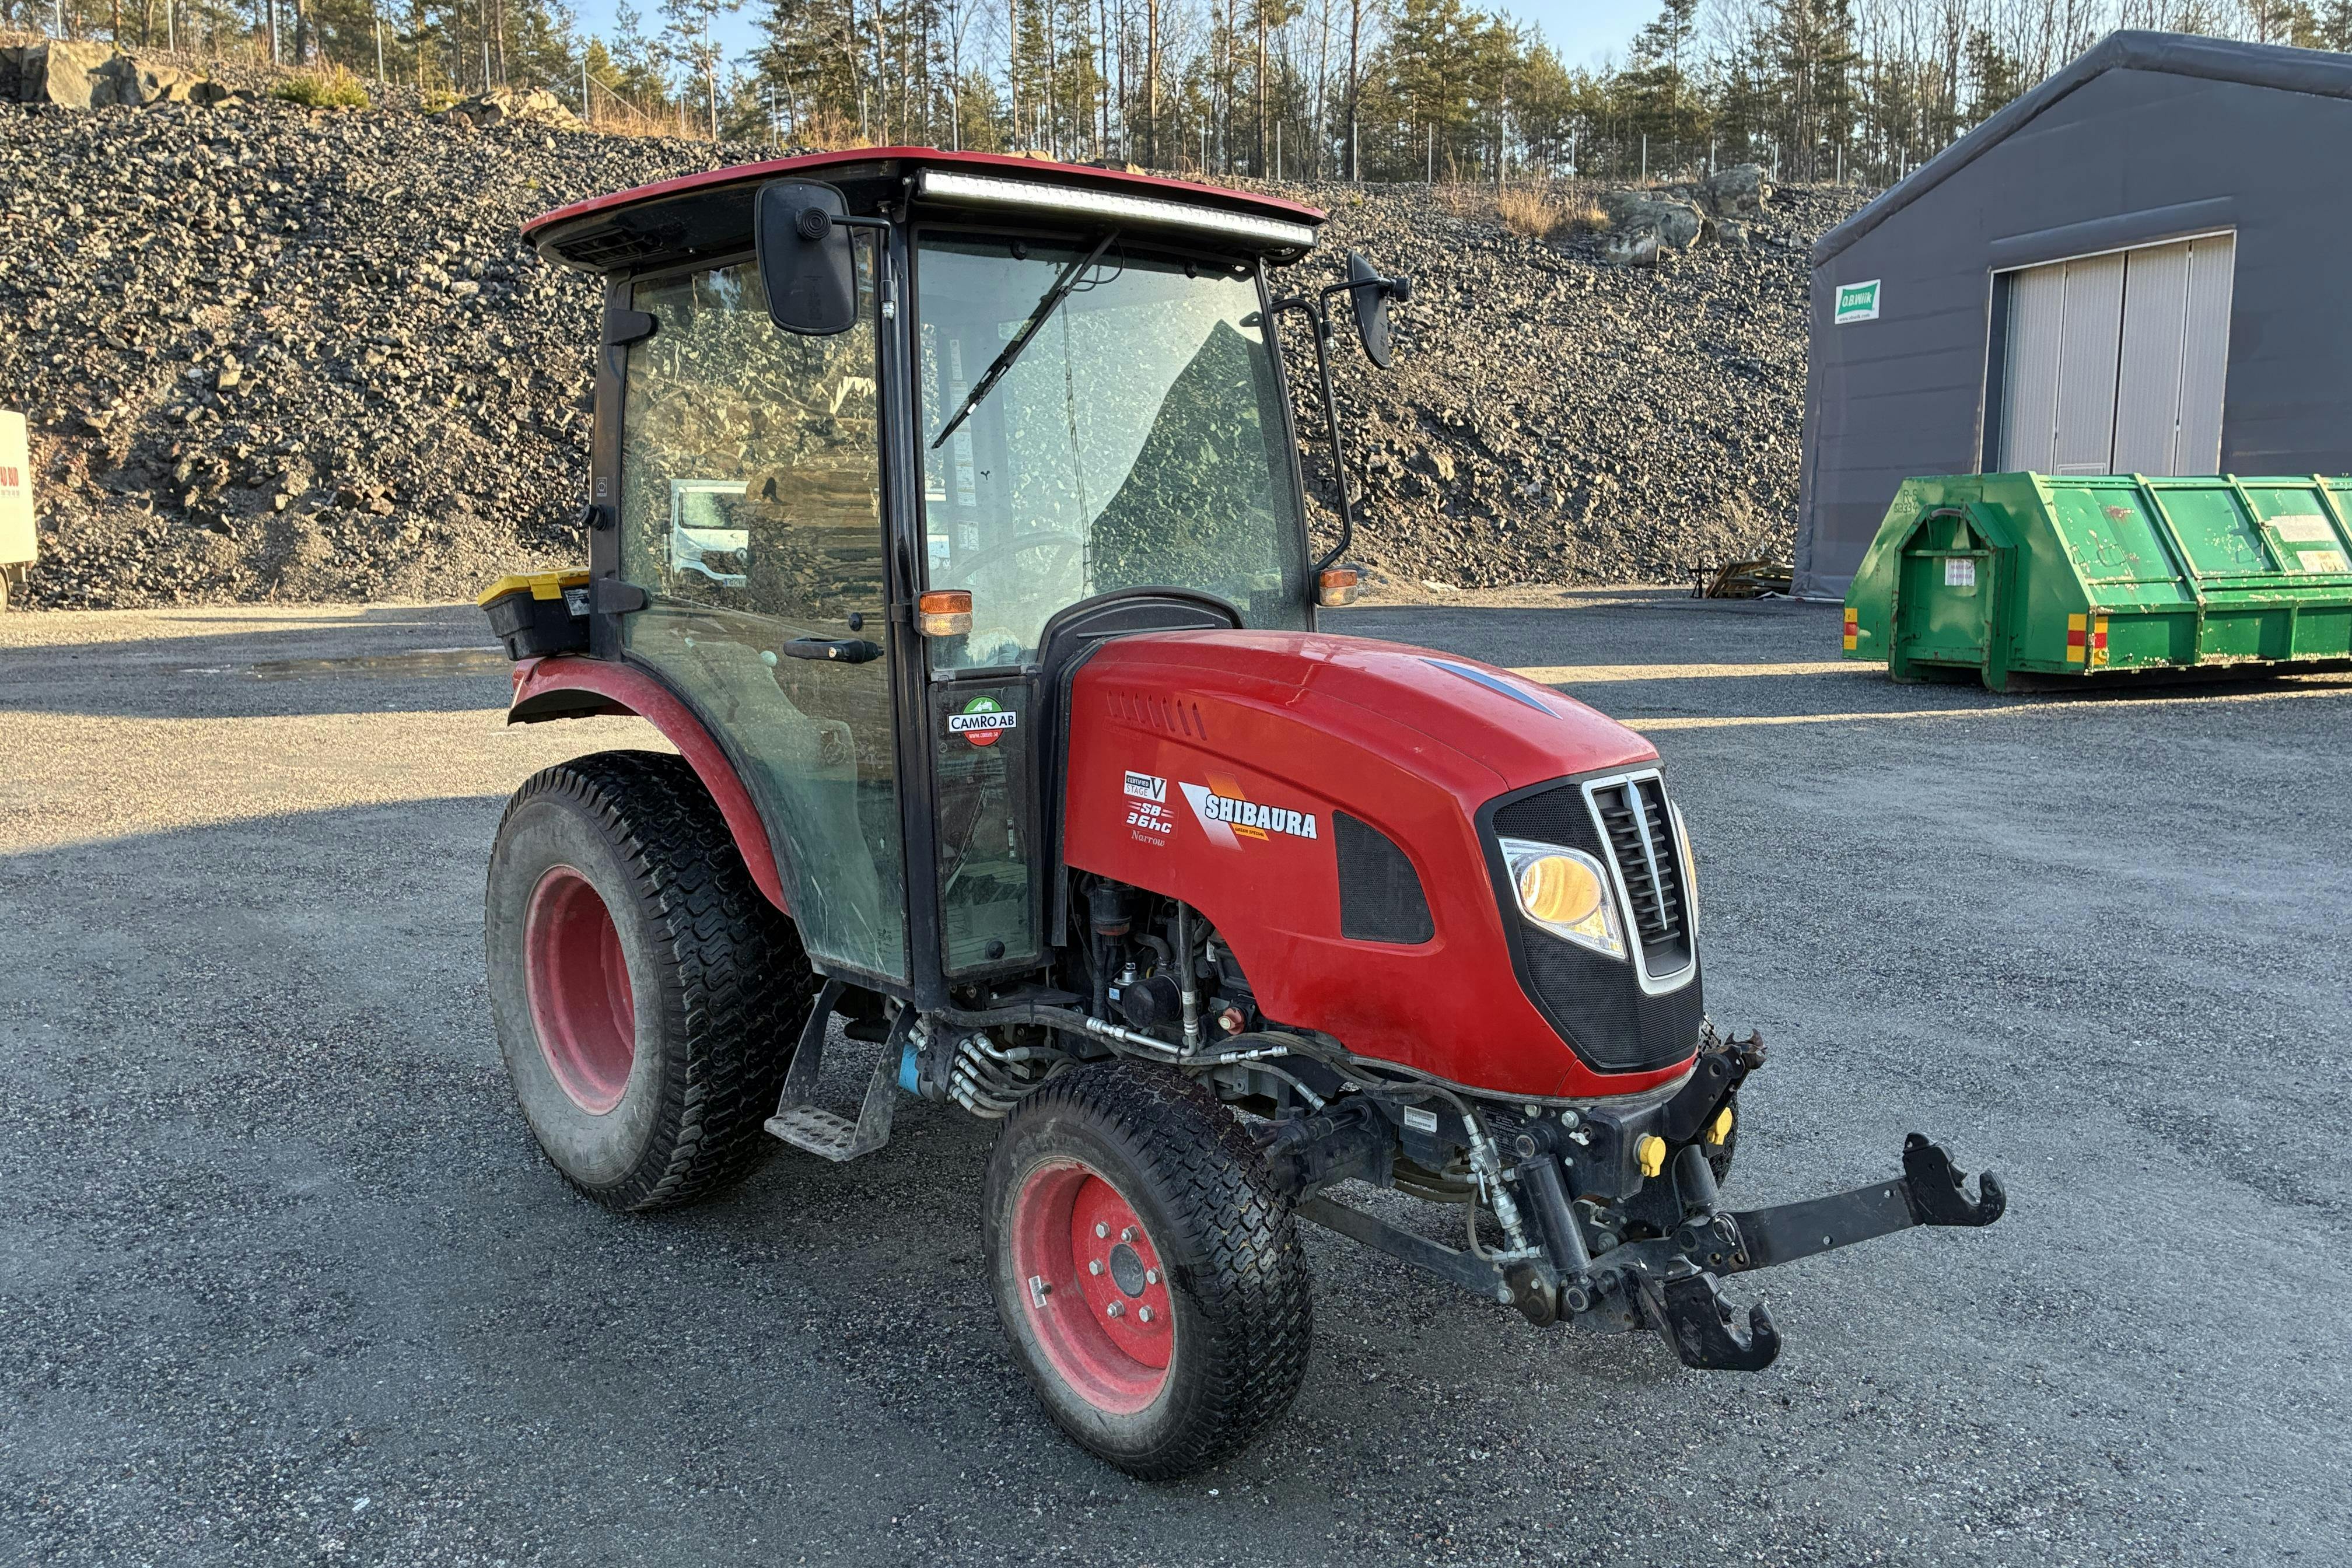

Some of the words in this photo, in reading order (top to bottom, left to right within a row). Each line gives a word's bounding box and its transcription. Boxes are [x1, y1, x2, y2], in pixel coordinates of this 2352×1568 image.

[951, 716, 997, 730] CAMRO
[999, 715, 1014, 726] AB
[1126, 784, 1148, 796] STAGE
[1150, 777, 1166, 799] V
[1127, 777, 1149, 787] CERTIFIED
[1140, 802, 1161, 817] SB
[1205, 793, 1318, 840] SHIBAURA
[1131, 830, 1166, 847] Narrow
